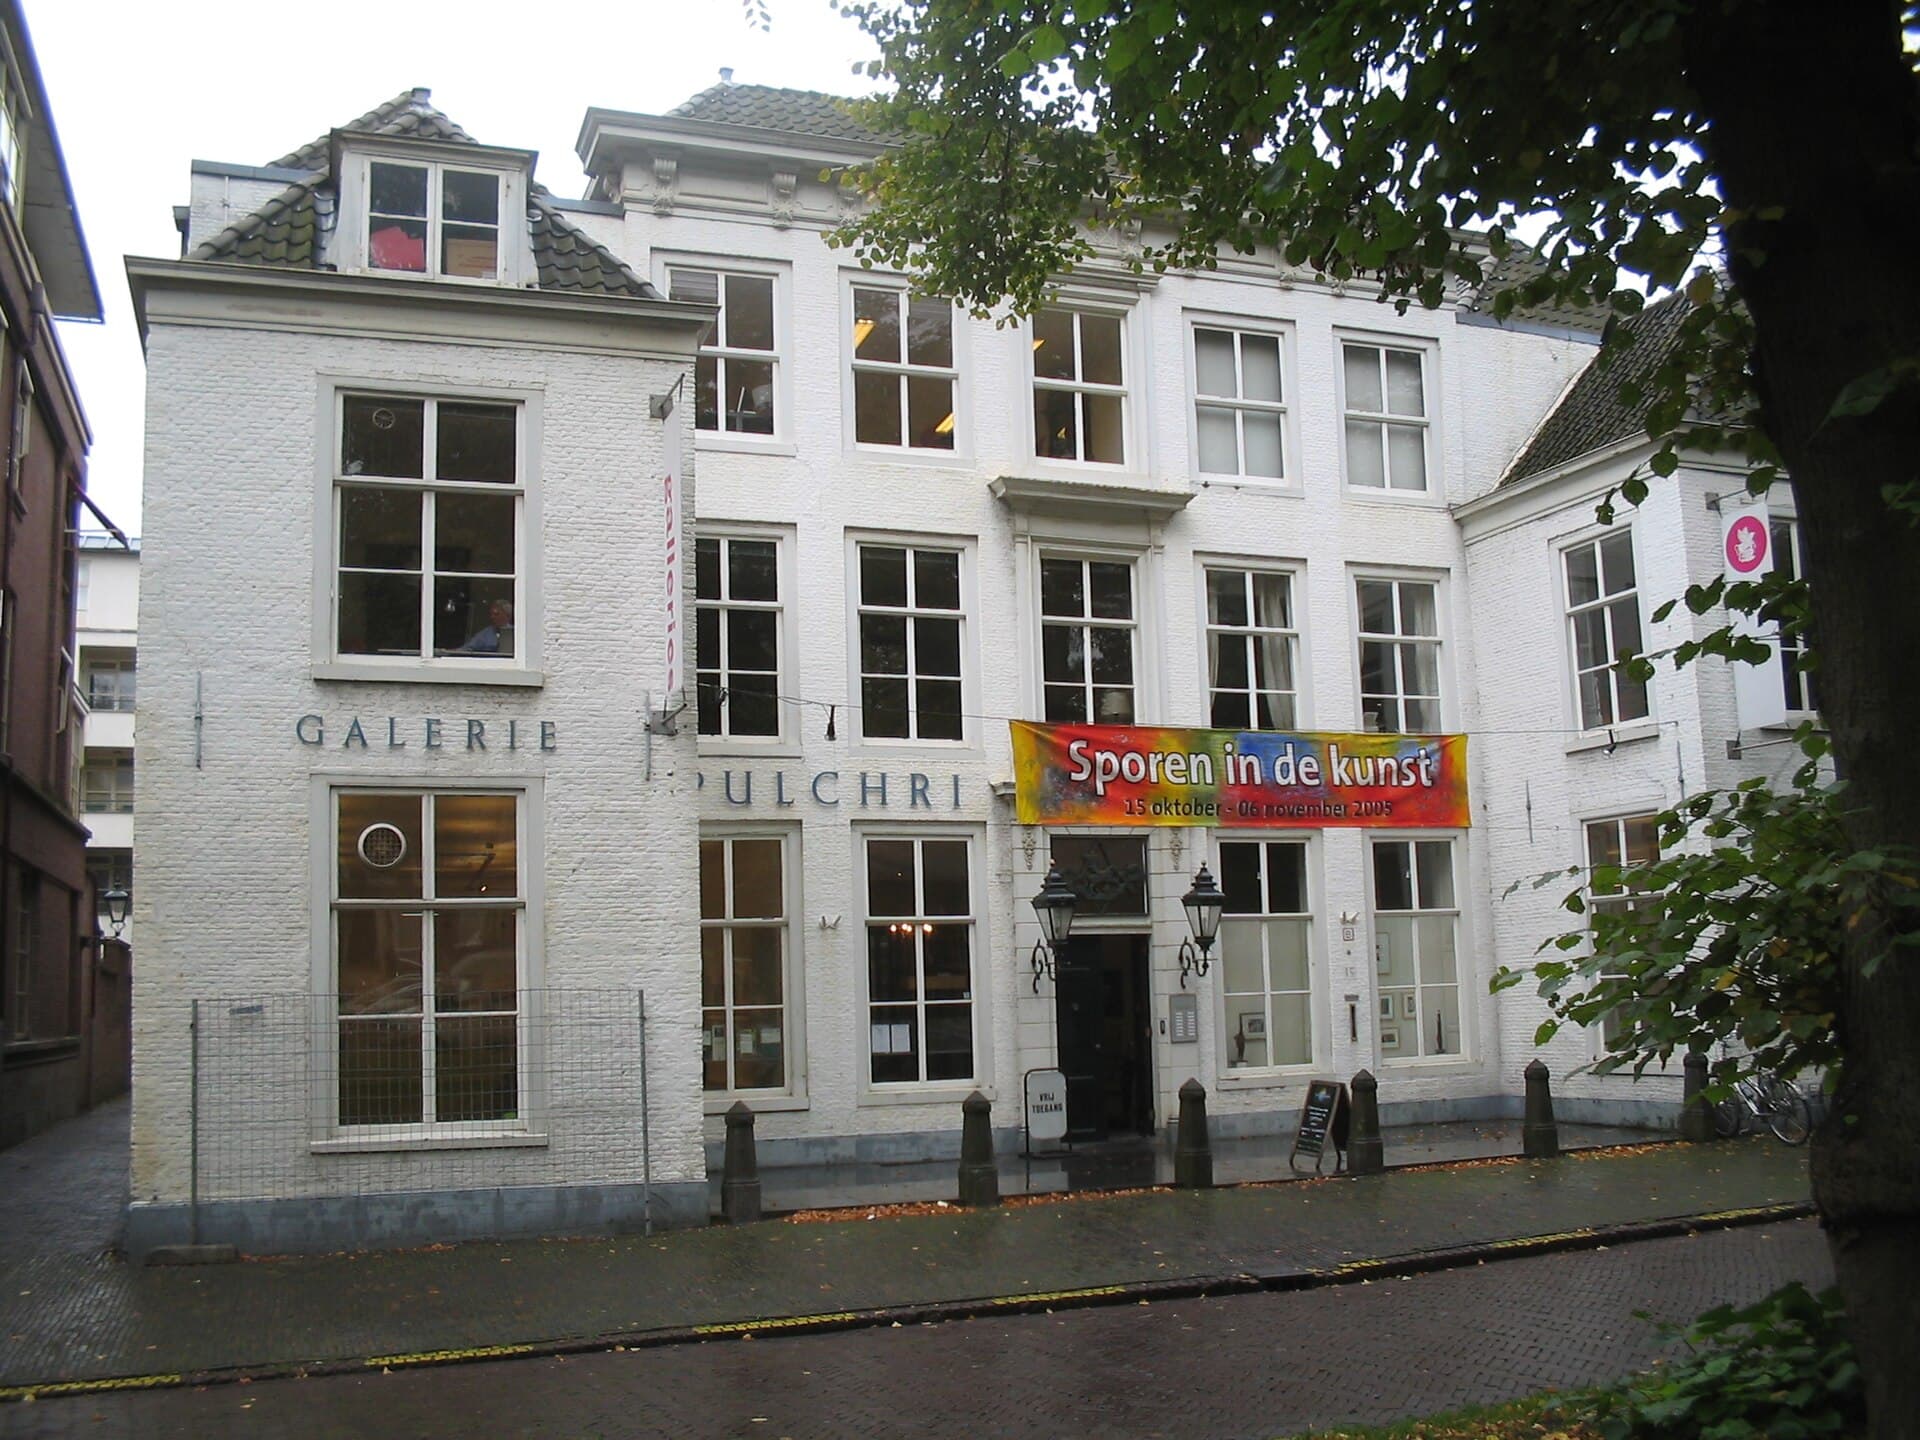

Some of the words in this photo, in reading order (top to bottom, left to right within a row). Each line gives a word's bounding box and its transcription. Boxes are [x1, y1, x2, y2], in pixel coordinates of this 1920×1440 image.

[296, 714, 557, 751] GALERIE
[1068, 739, 1214, 796] Sporen
[1223, 742, 1262, 786] in
[1273, 741, 1321, 787] de
[1328, 743, 1434, 788] kunst
[1125, 799, 1146, 816] 15
[1151, 798, 1220, 817] oktober
[1236, 800, 1257, 817] 06
[1263, 801, 1348, 818] november
[1352, 800, 1393, 818] 2005
[1039, 1092, 1055, 1102] VRIJ
[1032, 1103, 1063, 1114] TOEGANG
